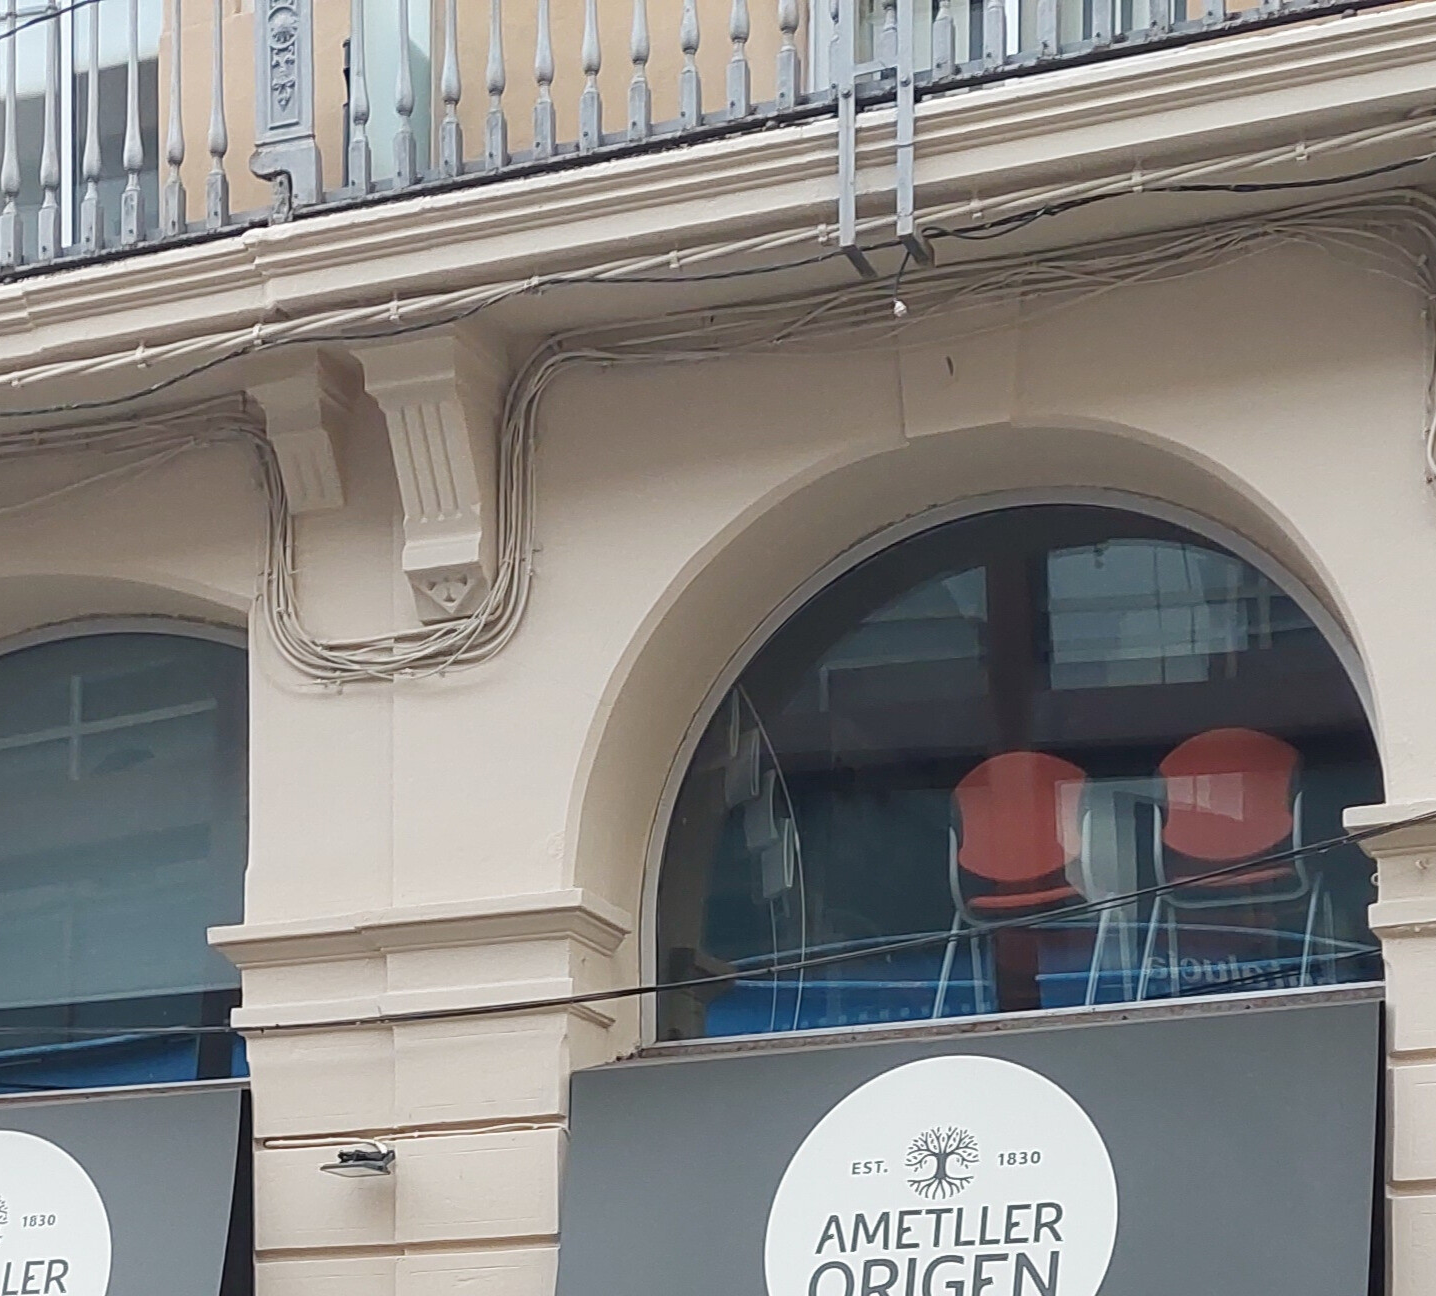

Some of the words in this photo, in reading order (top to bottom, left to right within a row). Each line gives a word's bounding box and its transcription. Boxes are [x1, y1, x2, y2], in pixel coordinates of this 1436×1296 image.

[851, 1160, 889, 1176] EST.
[997, 1150, 1042, 1168] 1830
[21, 1213, 57, 1230] 1830
[815, 1202, 1064, 1255] AMETLLER
